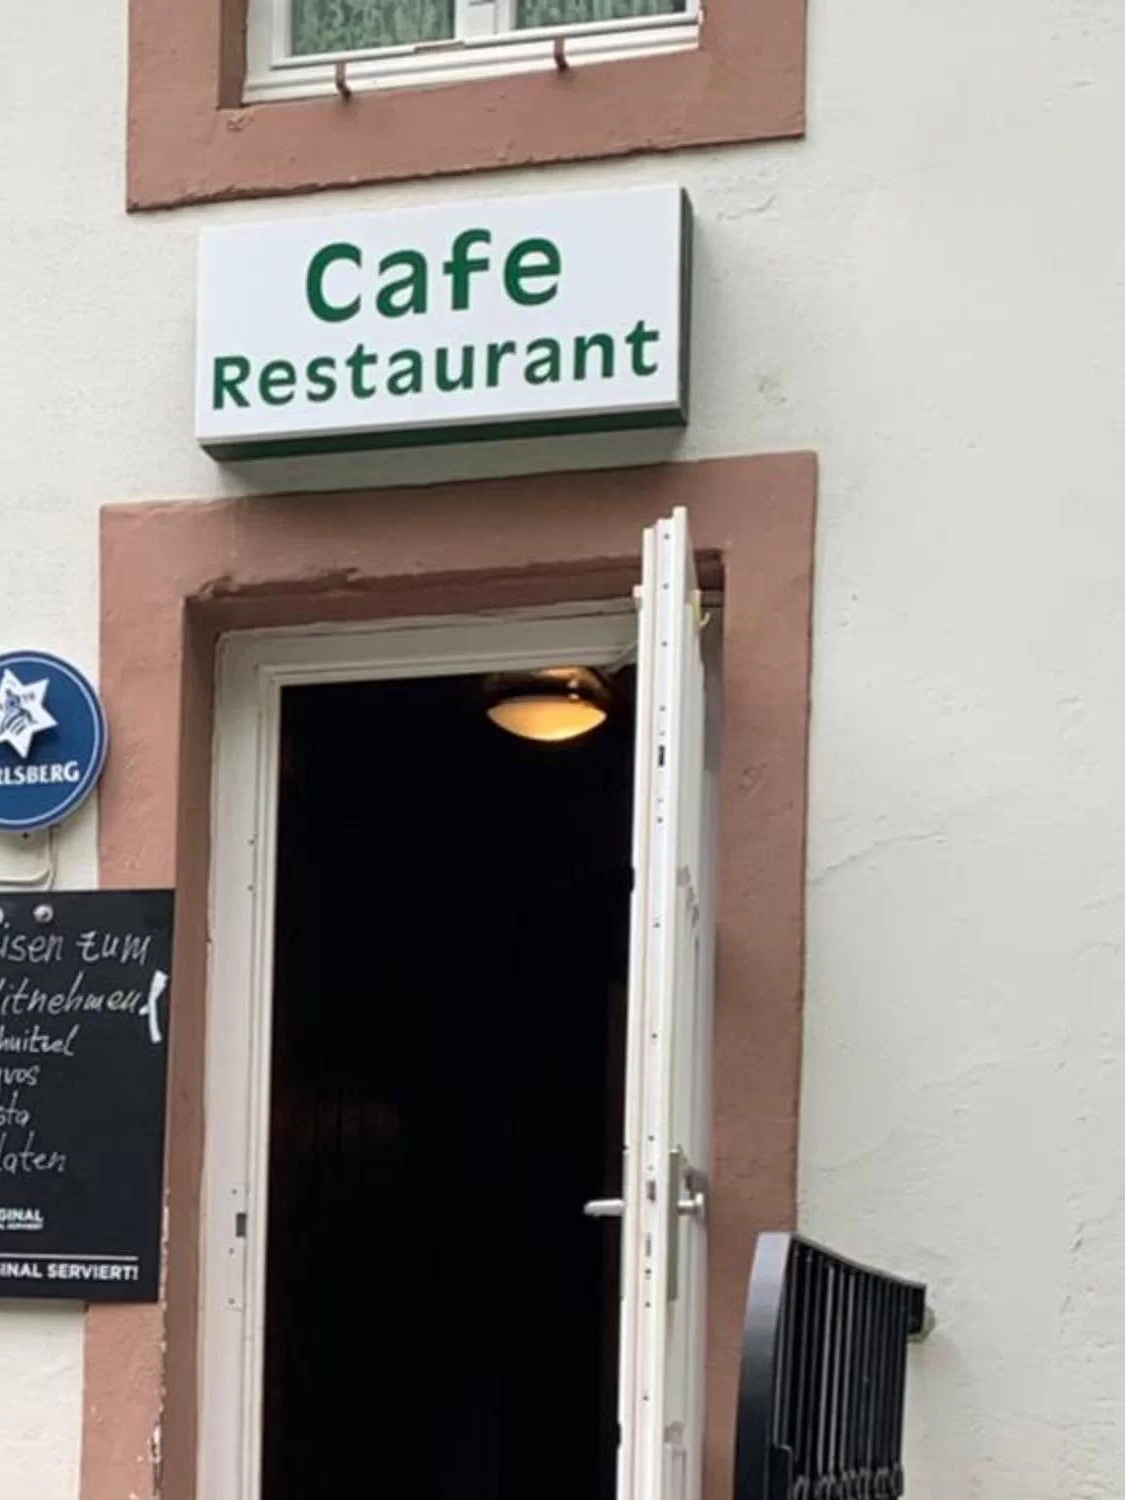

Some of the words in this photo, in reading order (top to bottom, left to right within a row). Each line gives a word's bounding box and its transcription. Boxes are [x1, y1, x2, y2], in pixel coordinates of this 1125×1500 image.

[306, 228, 562, 322] Cafe
[212, 319, 660, 411] Restaurant
[76, 930, 152, 966] zum
[47, 1264, 139, 1281] SERVIERT!
